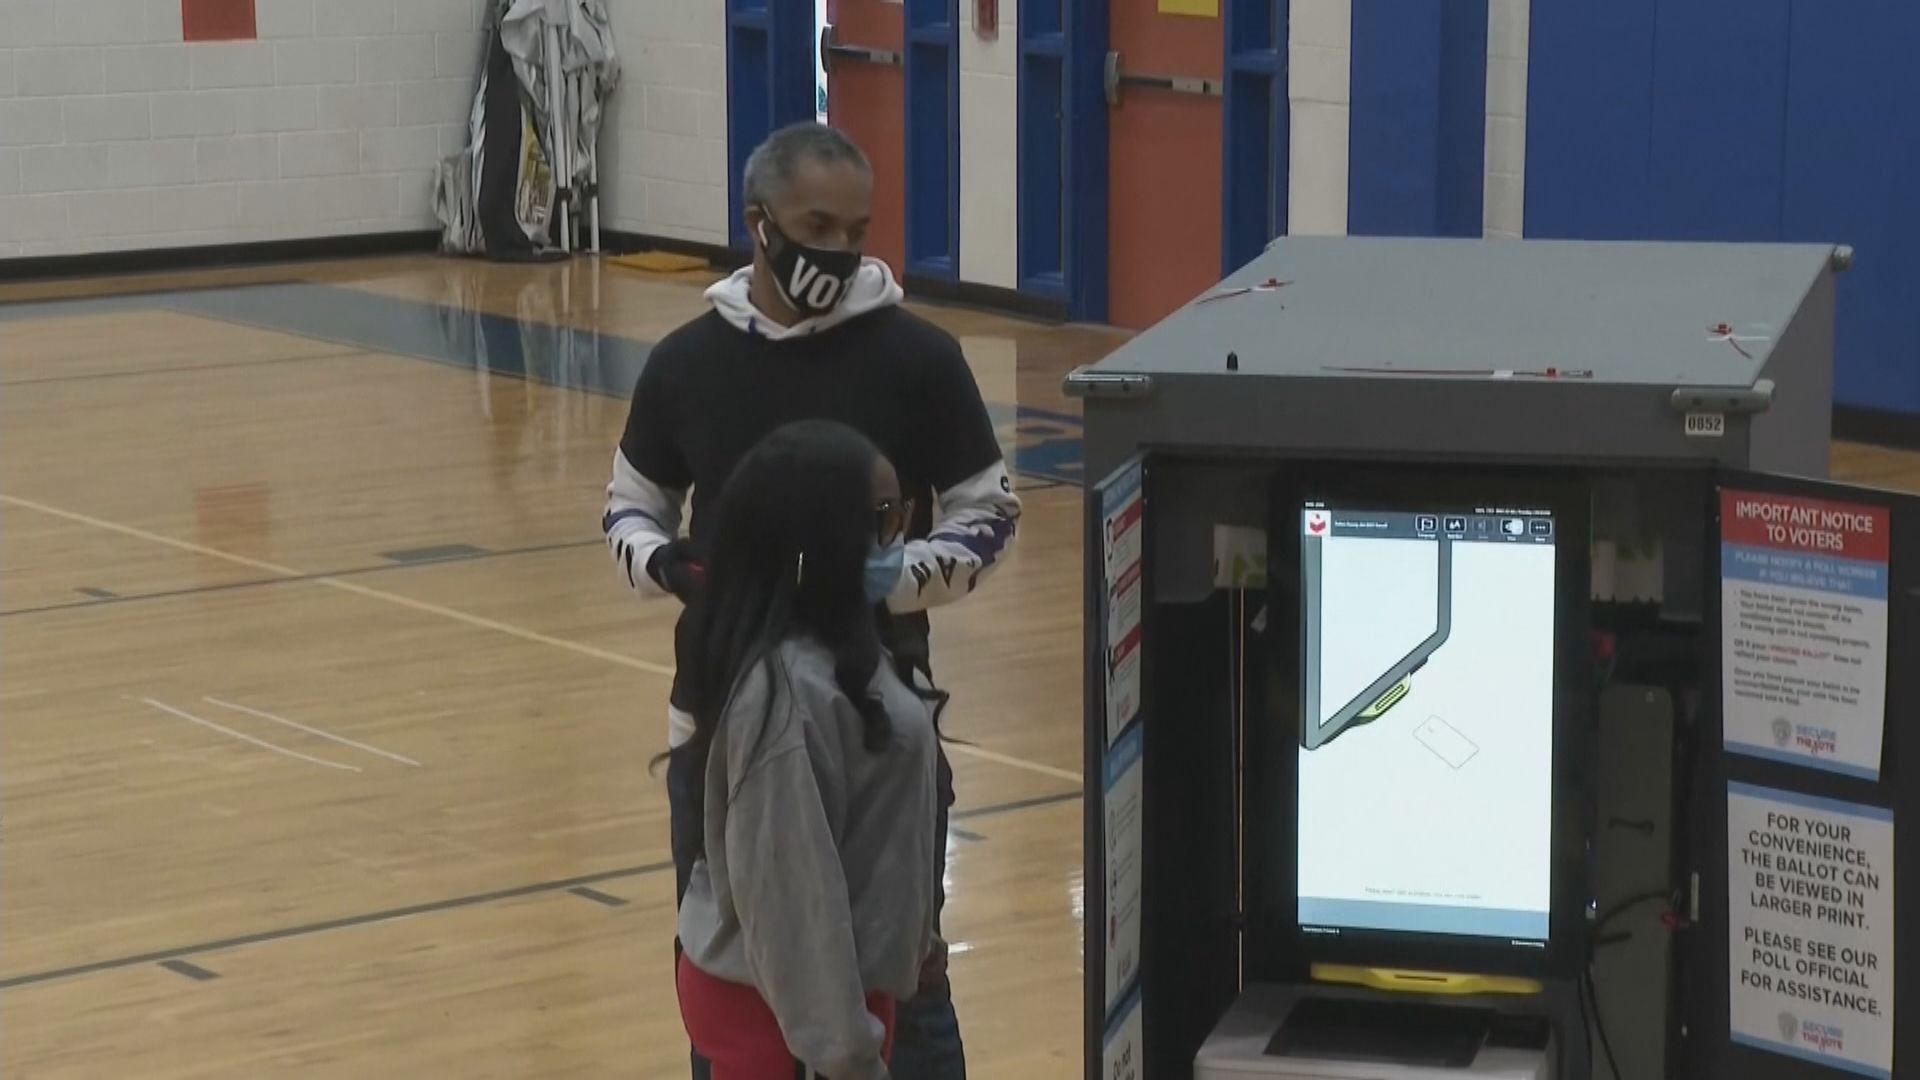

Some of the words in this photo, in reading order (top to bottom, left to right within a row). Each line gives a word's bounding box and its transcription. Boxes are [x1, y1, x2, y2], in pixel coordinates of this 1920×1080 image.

[1688, 416, 1722, 431] 0852
[1736, 501, 1819, 525] IMPORTANT
[1821, 511, 1873, 533] NOTICE
[1766, 524, 1786, 542] TO
[1789, 527, 1844, 550] VOTERS
[1735, 551, 1768, 565] PLEASE
[1796, 725, 1836, 740] SECURE
[1796, 735, 1813, 748] THE
[1767, 812, 1800, 833] FOR
[1805, 819, 1851, 842] YOUR
[1749, 830, 1871, 869] CONVENIENCE,
[1741, 849, 1771, 868] THE
[1776, 857, 1838, 881] BALLOT
[1843, 870, 1879, 890] CAN
[1755, 872, 1775, 889] BE
[1780, 877, 1842, 903] VIEWED
[1848, 891, 1864, 909] IN
[1750, 892, 1812, 918] LARGER
[1817, 905, 1869, 930] PRINT.
[1745, 927, 1802, 953] PLEASE
[1807, 940, 1837, 961] SEE
[1841, 948, 1878, 970] OUR
[1752, 948, 1790, 971] POLL
[1796, 959, 1868, 989] OFFICIAL
[1741, 969, 1772, 991] FOR
[1776, 979, 1882, 1016] ASSISTANCE.
[1802, 1020, 1843, 1037] SECURE
[1802, 1032, 1819, 1044] THE
